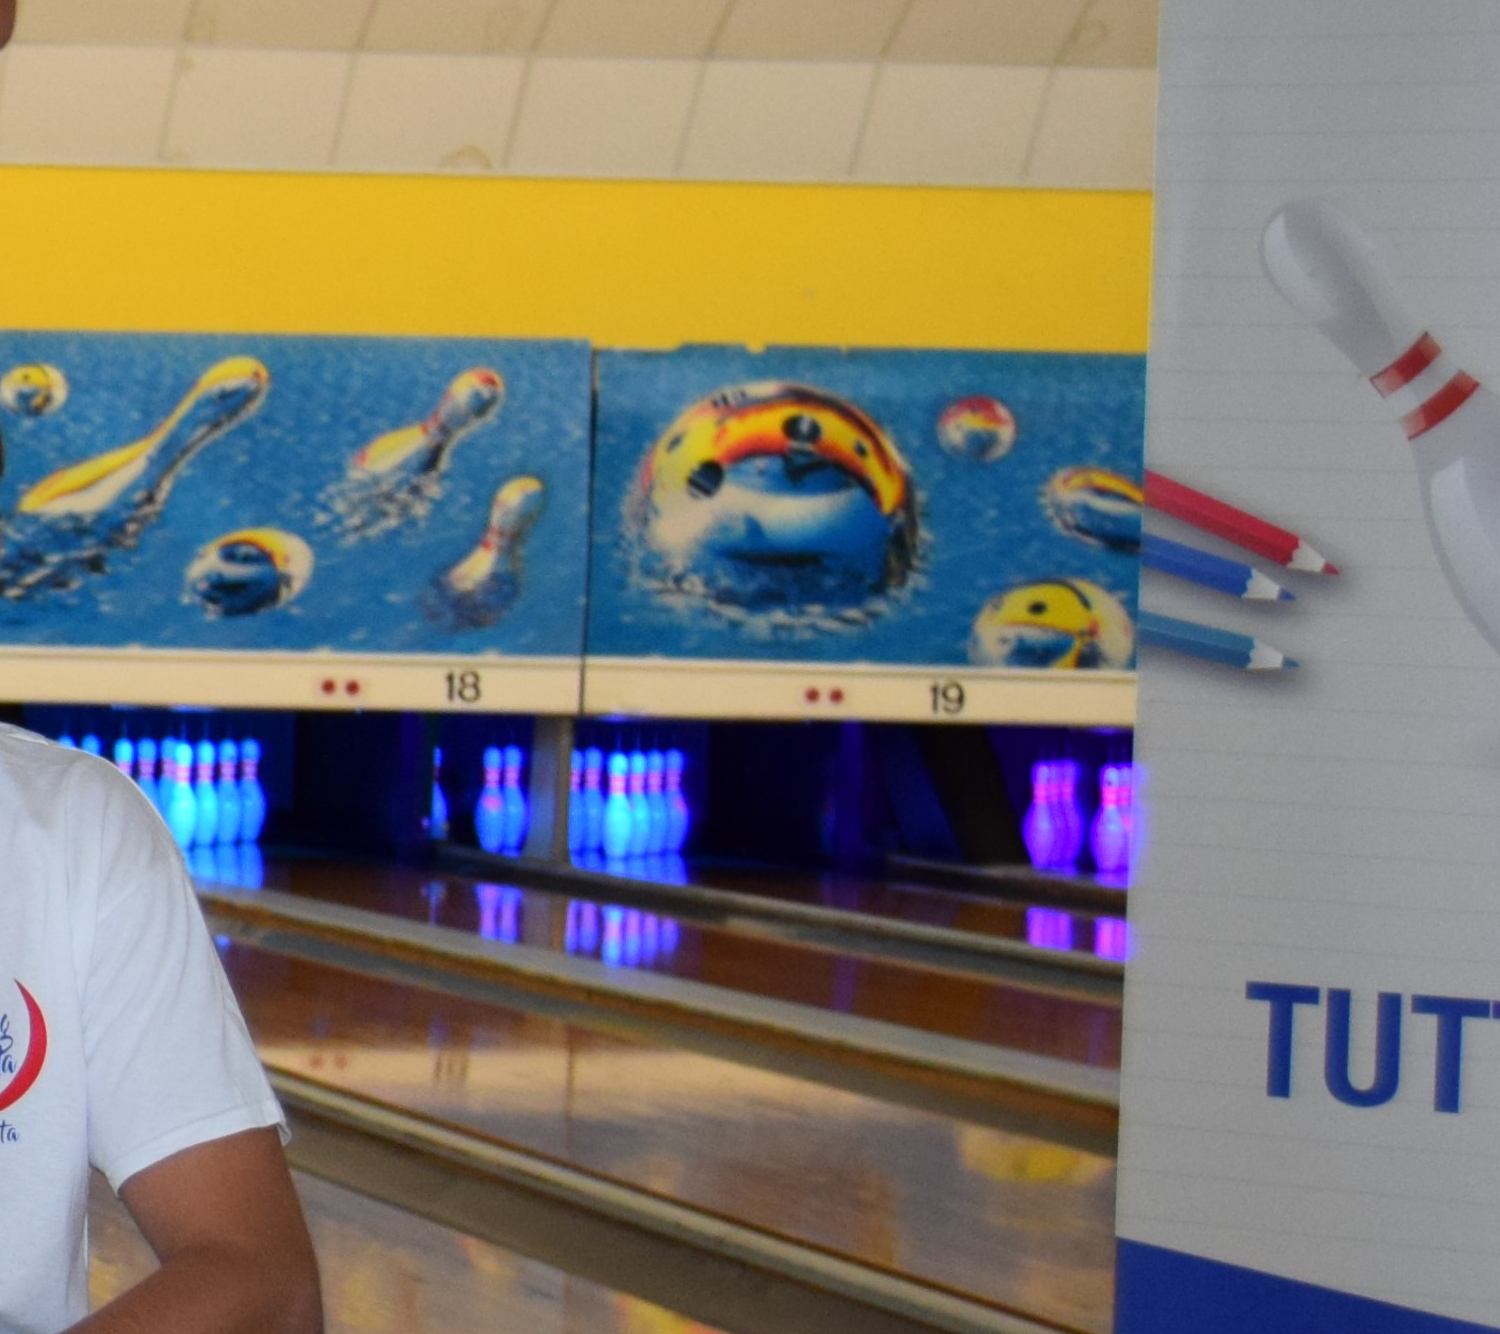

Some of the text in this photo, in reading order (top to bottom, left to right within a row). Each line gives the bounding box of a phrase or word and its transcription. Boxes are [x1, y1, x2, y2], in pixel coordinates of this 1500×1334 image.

[445, 671, 482, 703] 18
[929, 683, 965, 715] 19
[1245, 980, 1500, 1115] TUT
